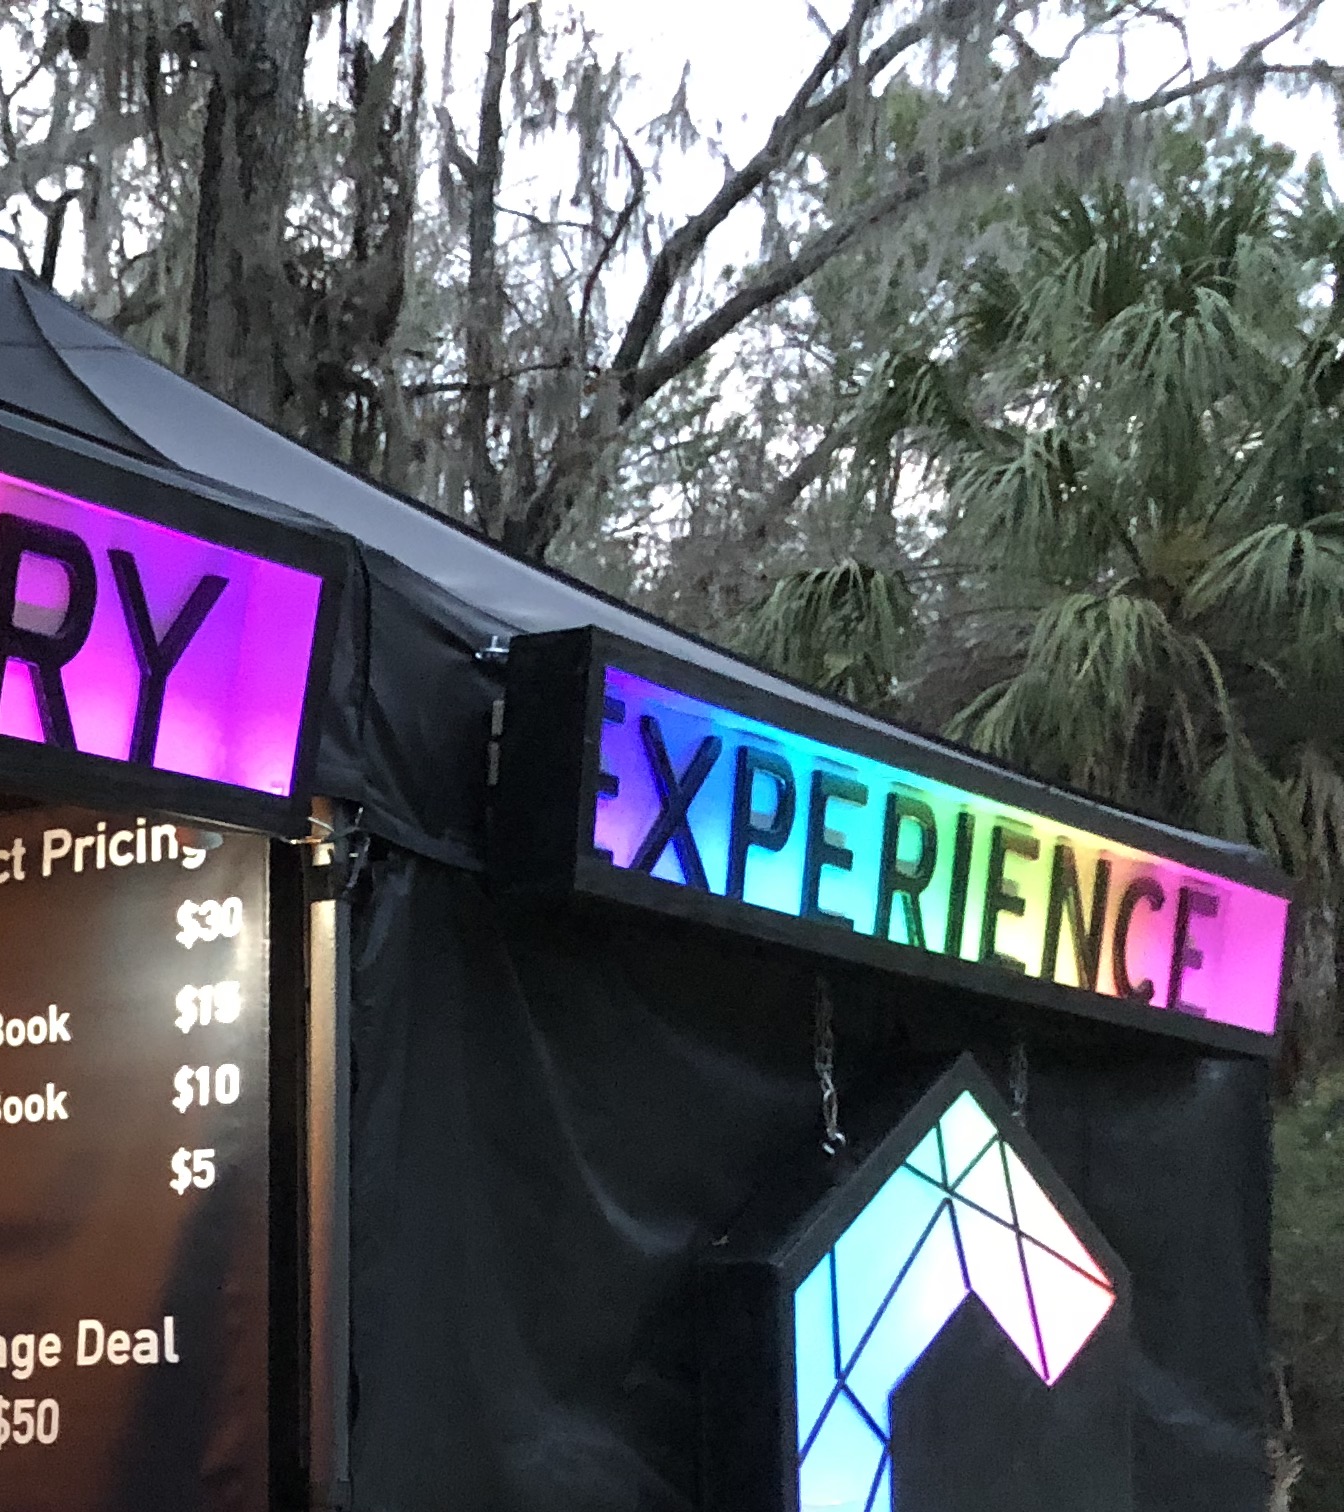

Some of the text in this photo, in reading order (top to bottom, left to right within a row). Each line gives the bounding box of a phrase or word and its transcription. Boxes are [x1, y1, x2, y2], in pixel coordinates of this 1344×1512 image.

[175, 897, 242, 948] $30
[173, 1064, 240, 1112] $10
[169, 1147, 216, 1196] $5
[76, 1316, 180, 1366] Deal
